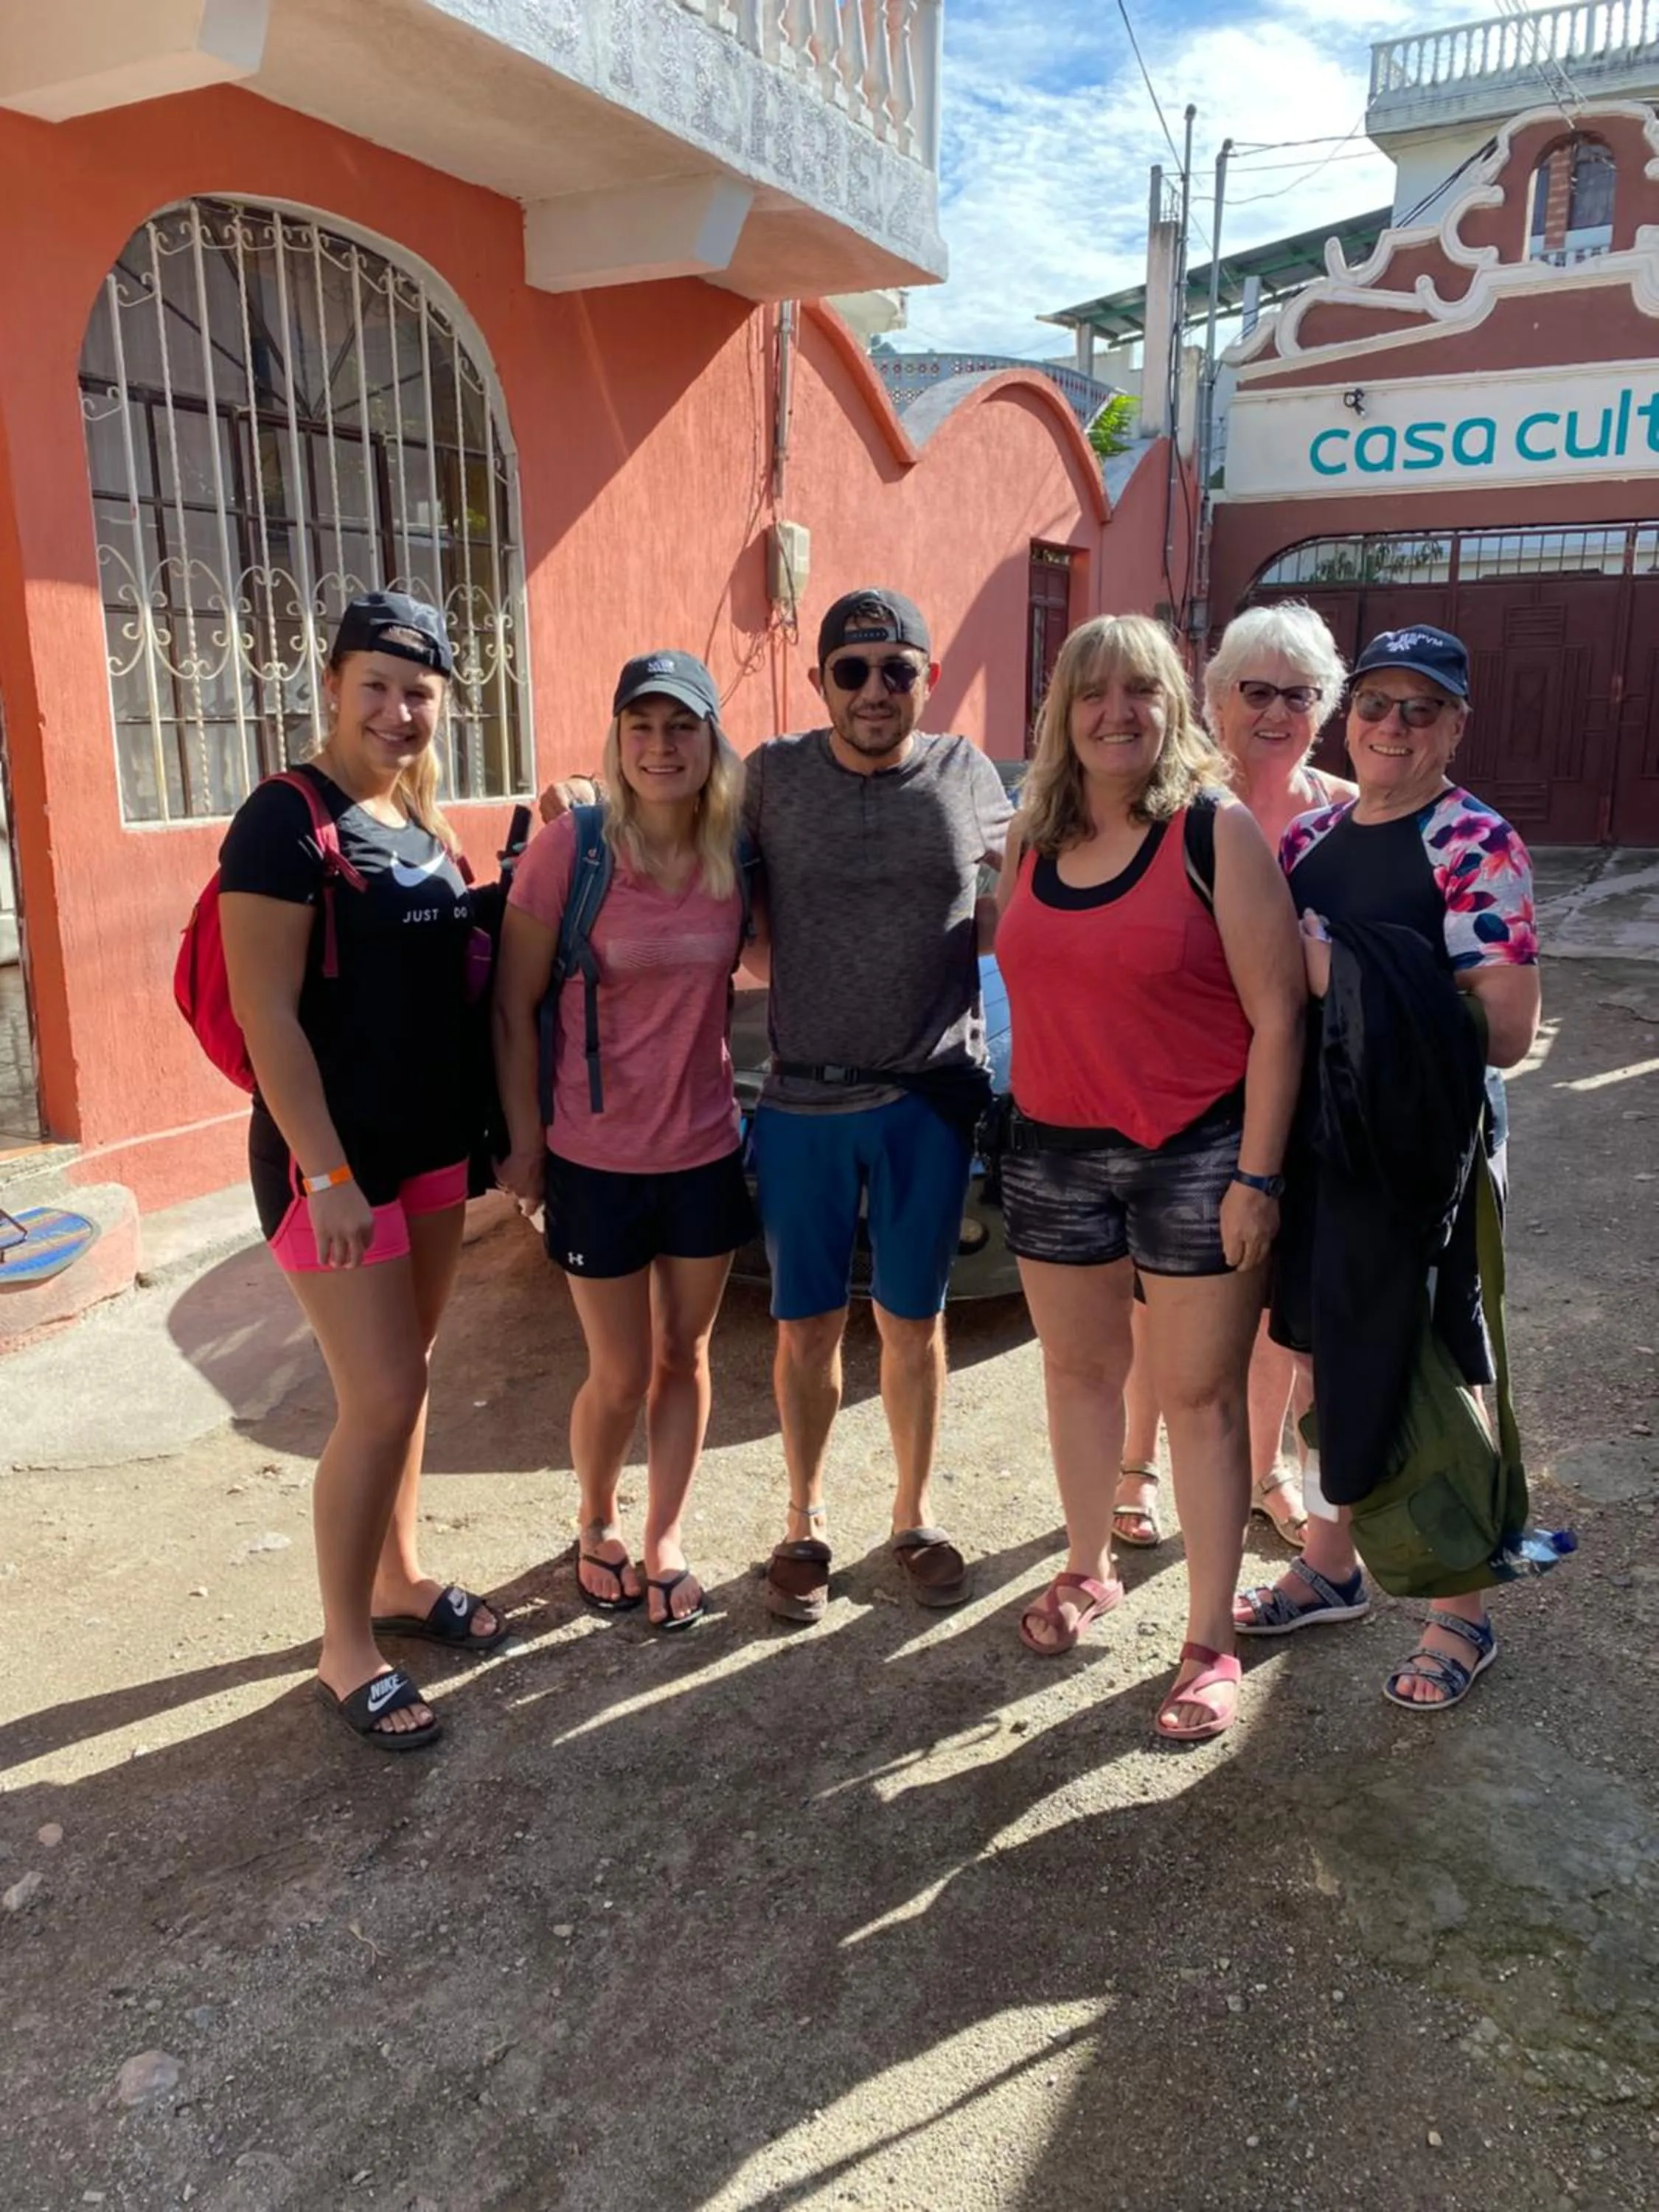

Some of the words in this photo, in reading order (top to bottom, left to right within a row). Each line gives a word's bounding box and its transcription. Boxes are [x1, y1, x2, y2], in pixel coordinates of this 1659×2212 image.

[1309, 417, 1497, 476] casa
[1515, 389, 1659, 461] cult
[402, 908, 439, 923] JUST
[453, 905, 467, 919] DO
[370, 1673, 399, 1700] NIKE
